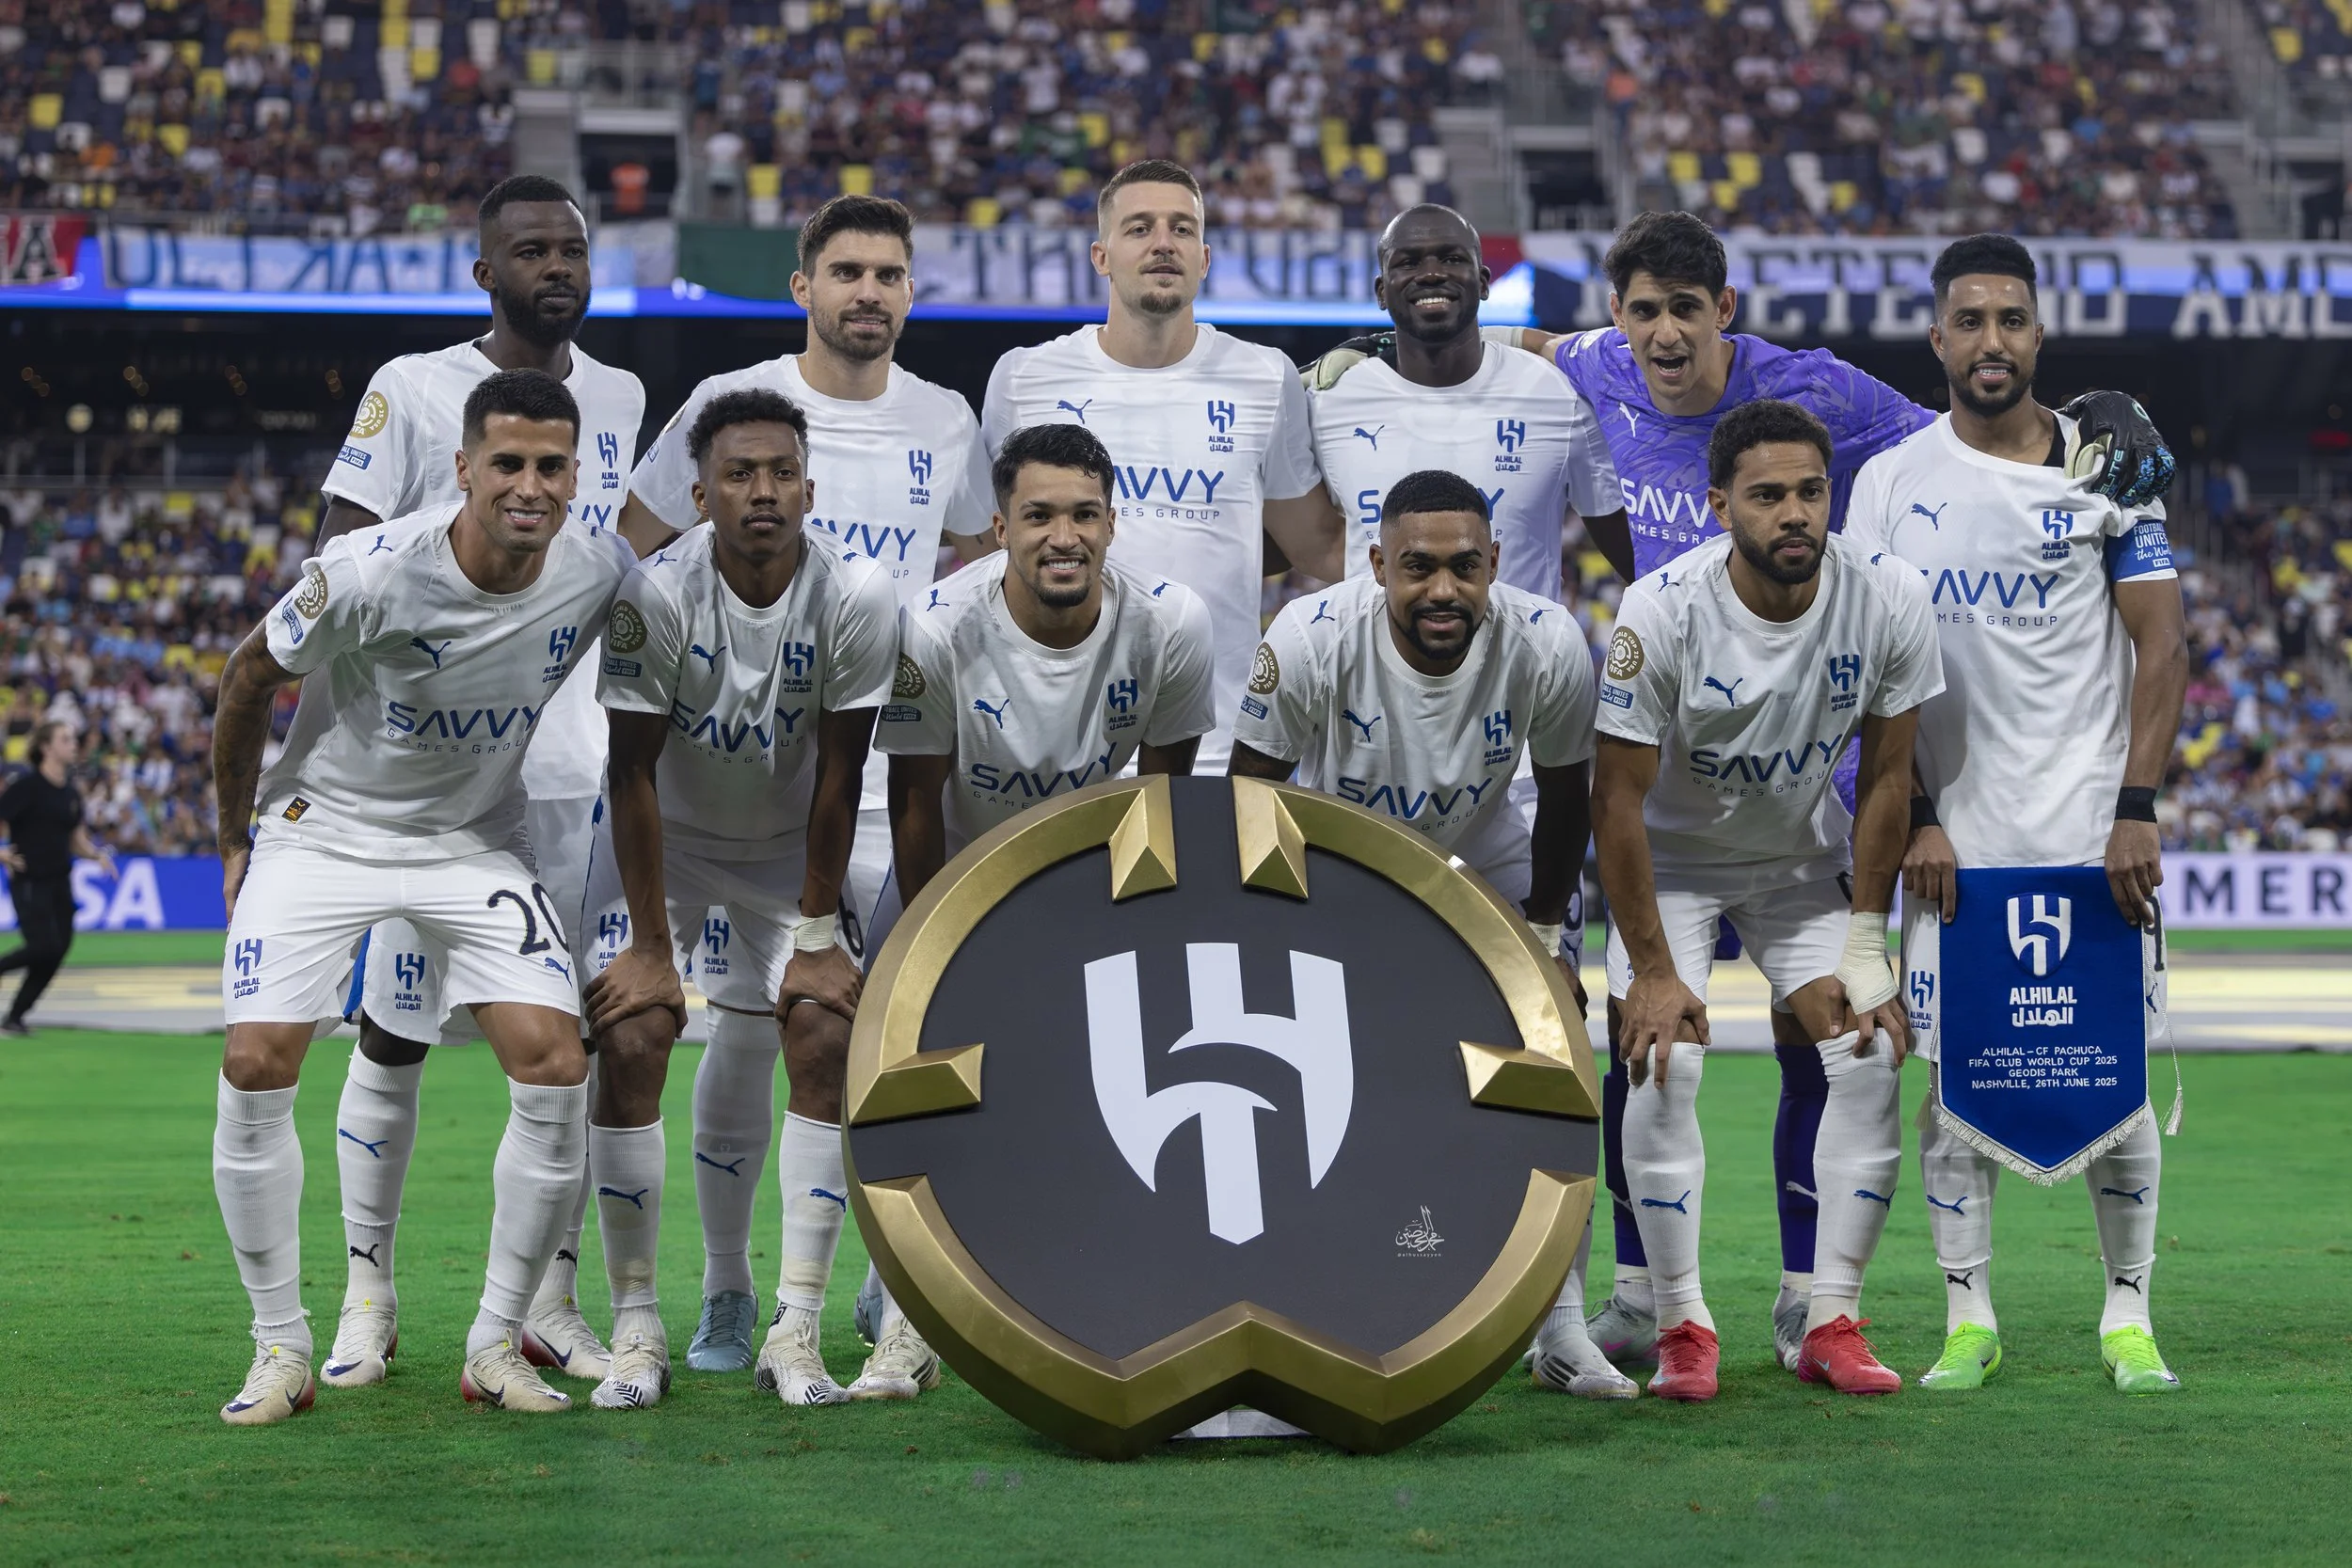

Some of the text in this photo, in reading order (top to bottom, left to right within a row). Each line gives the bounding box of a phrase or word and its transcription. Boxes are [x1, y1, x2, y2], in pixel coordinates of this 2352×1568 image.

[351, 425, 365, 436] IFA
[1208, 436, 1234, 445] ALHILAL
[1209, 444, 1233, 452] الهلال
[1495, 455, 1522, 464] ALHILAL
[1113, 466, 1224, 504] AVVY
[910, 488, 930, 497] ALHILAL
[910, 497, 929, 505] الهلال
[1620, 478, 1710, 529] SAVV
[1156, 508, 1220, 520] GROUP
[1630, 523, 1669, 540] AMES
[2134, 523, 2164, 535] FOOTBALL
[2136, 532, 2169, 548] UNITES
[2042, 551, 2069, 560] الهلال
[2135, 548, 2153, 561] the
[1920, 569, 2058, 609] AVVY
[628, 610, 640, 623] CUP
[1938, 613, 2058, 626] MES GROUP
[630, 634, 642, 646] USA
[1628, 636, 1638, 649] CUP
[1633, 651, 1640, 659] 25
[906, 662, 918, 675] CUP
[1626, 660, 1638, 673] USA
[783, 678, 813, 687] ALHILAL
[1612, 688, 1629, 700] UNITES
[387, 701, 547, 739] SAVVY
[1108, 714, 1138, 723] ALHILAL
[671, 698, 805, 752] SAVVY
[1109, 721, 1136, 730] الهلال
[387, 727, 524, 754] GAMES GROU
[679, 736, 804, 764] AMES GRUP
[1484, 747, 1512, 758] ALHILAL
[1690, 734, 1842, 783] SAVVY
[970, 741, 1117, 798] SAVVY
[1693, 770, 1825, 798] GAMES GROU
[973, 790, 1032, 809] GAME
[1337, 777, 1492, 819] SAVVY
[1421, 803, 1486, 831] GROUP
[2183, 863, 2344, 916] MER
[599, 951, 617, 960] ALHI
[705, 958, 729, 966] ALHILAL
[705, 966, 728, 975] الهلال
[233, 977, 260, 990] ALHILAL
[234, 988, 259, 999] الهلال
[395, 993, 422, 1002] ALHILAL
[2010, 987, 2077, 1006] ALHILAL
[395, 1002, 421, 1011] الهلال
[1910, 1010, 1932, 1021] ALHILAL
[2011, 1007, 2074, 1027] الهلال
[1911, 1021, 1931, 1030] الهلال
[2054, 1046, 2103, 1055] PACHUCA
[1969, 1056, 2117, 1068] FIFA CLUB WORLD CUP 2025
[2009, 1068, 2078, 1077] GEODIS PARK
[1972, 1077, 2117, 1089] NASHVILLE, 26TH JUNE 2025
